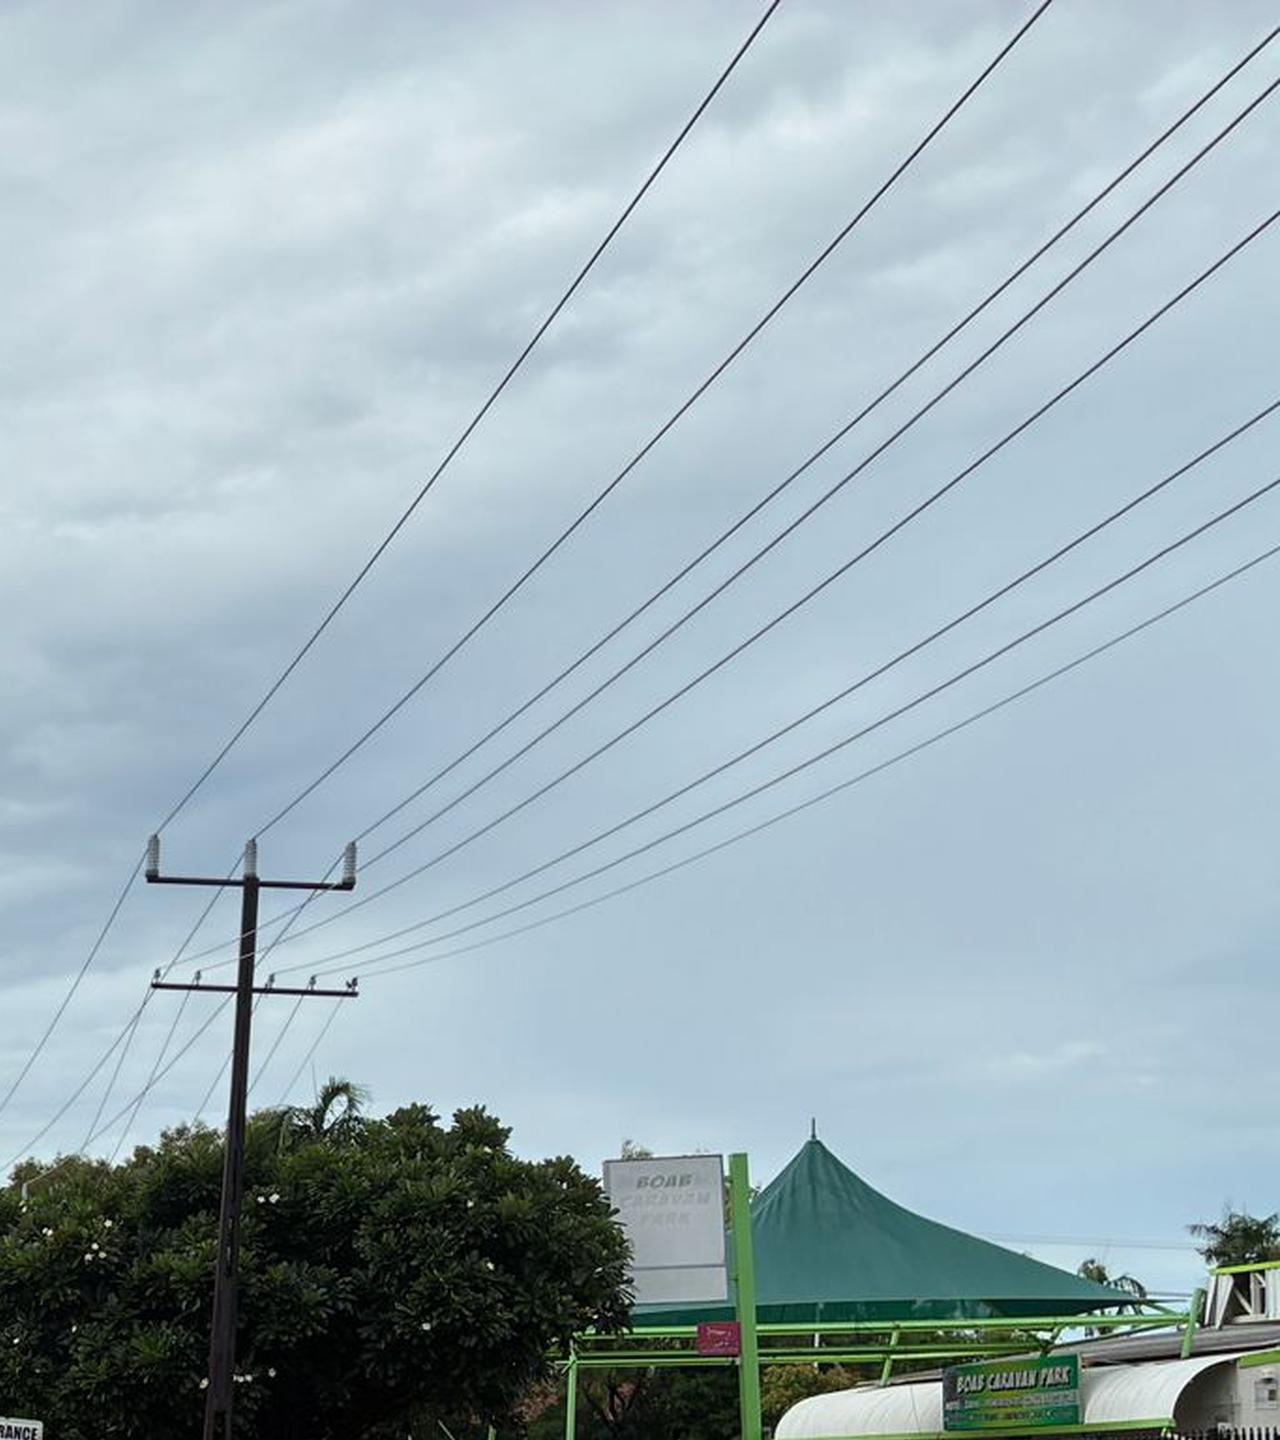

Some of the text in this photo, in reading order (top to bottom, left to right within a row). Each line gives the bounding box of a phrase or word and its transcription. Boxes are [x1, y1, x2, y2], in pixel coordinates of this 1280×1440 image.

[637, 1173, 693, 1189] BOAB
[956, 1366, 1071, 1395] BOAB CARAVAN PARK
